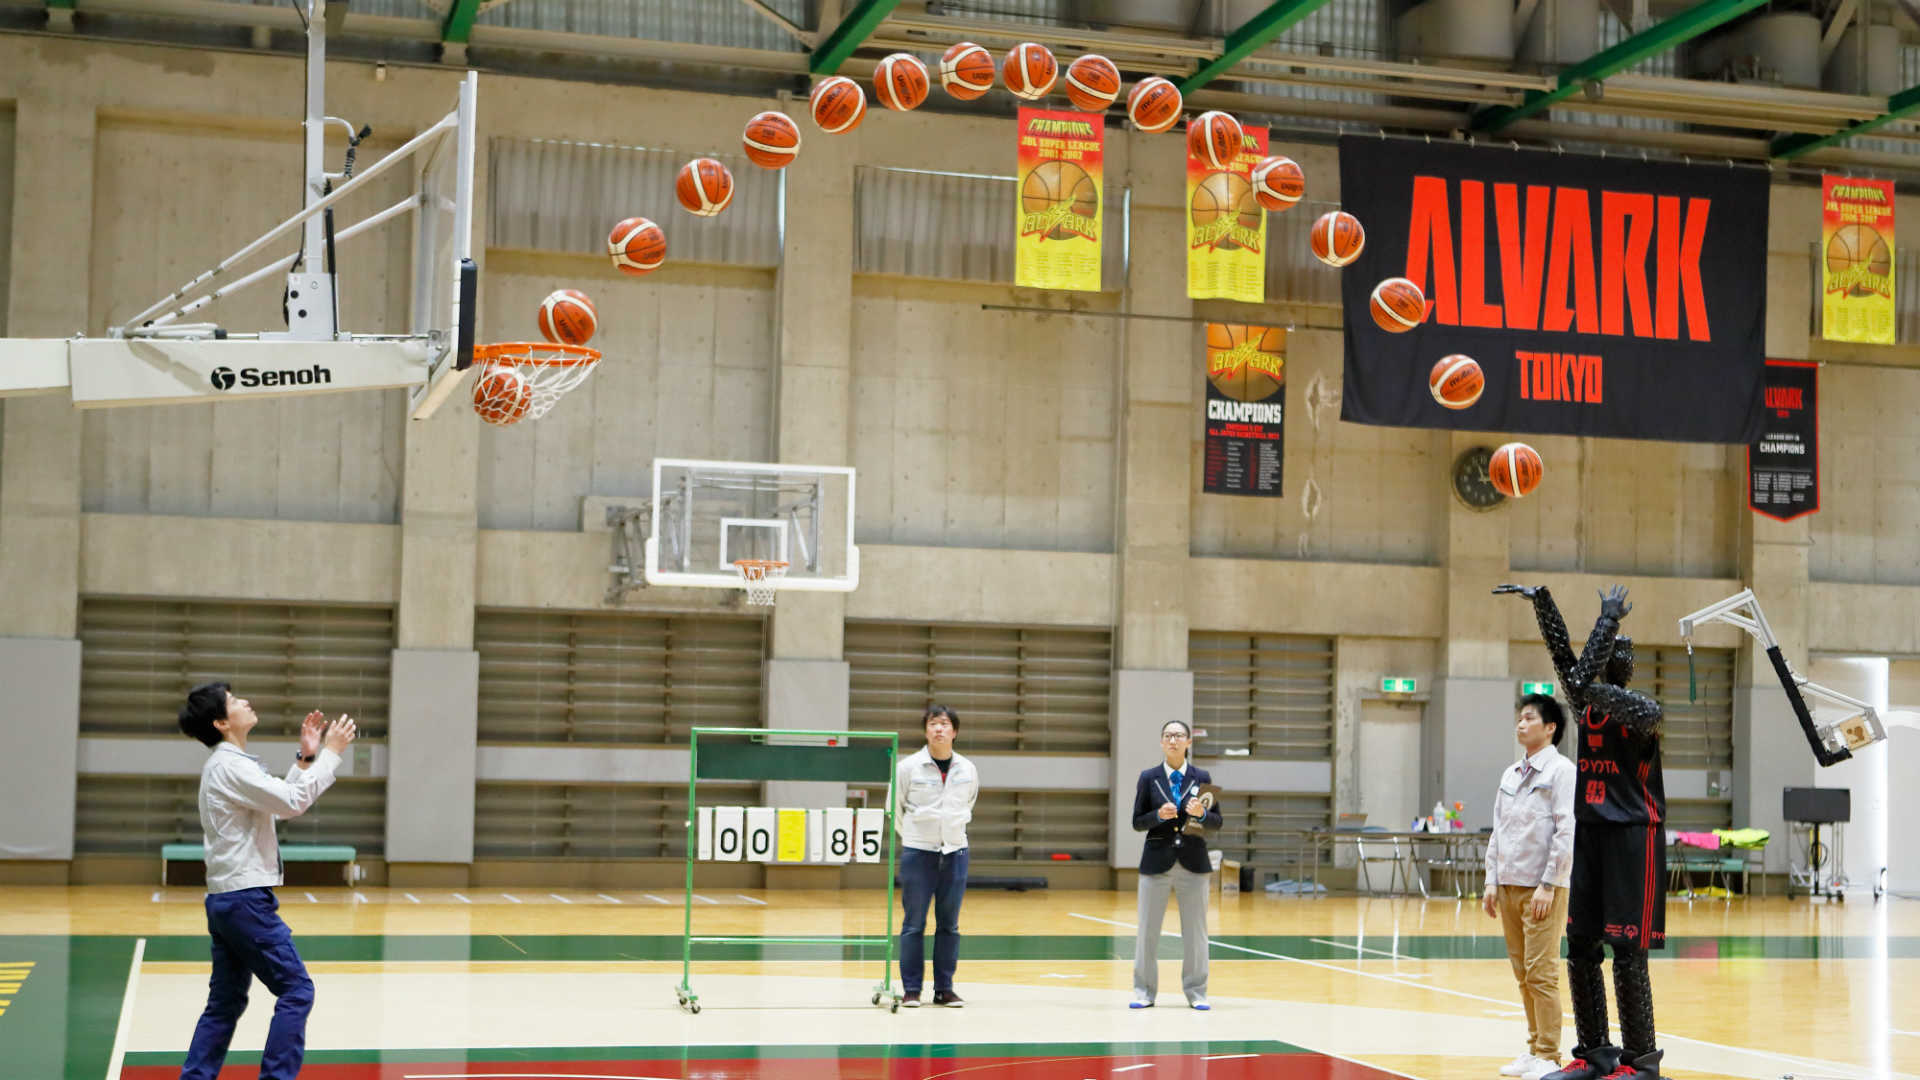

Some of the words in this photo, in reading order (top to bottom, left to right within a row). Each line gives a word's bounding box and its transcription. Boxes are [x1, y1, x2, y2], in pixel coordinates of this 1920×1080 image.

[1027, 118, 1096, 138] CHAMPIONS
[1405, 175, 1712, 342] ALVARK
[240, 364, 332, 387] Senoh
[1515, 350, 1603, 404] TOKYO
[1208, 399, 1282, 424] CHAMPIONS
[1760, 442, 1805, 454] CHAMPIONS
